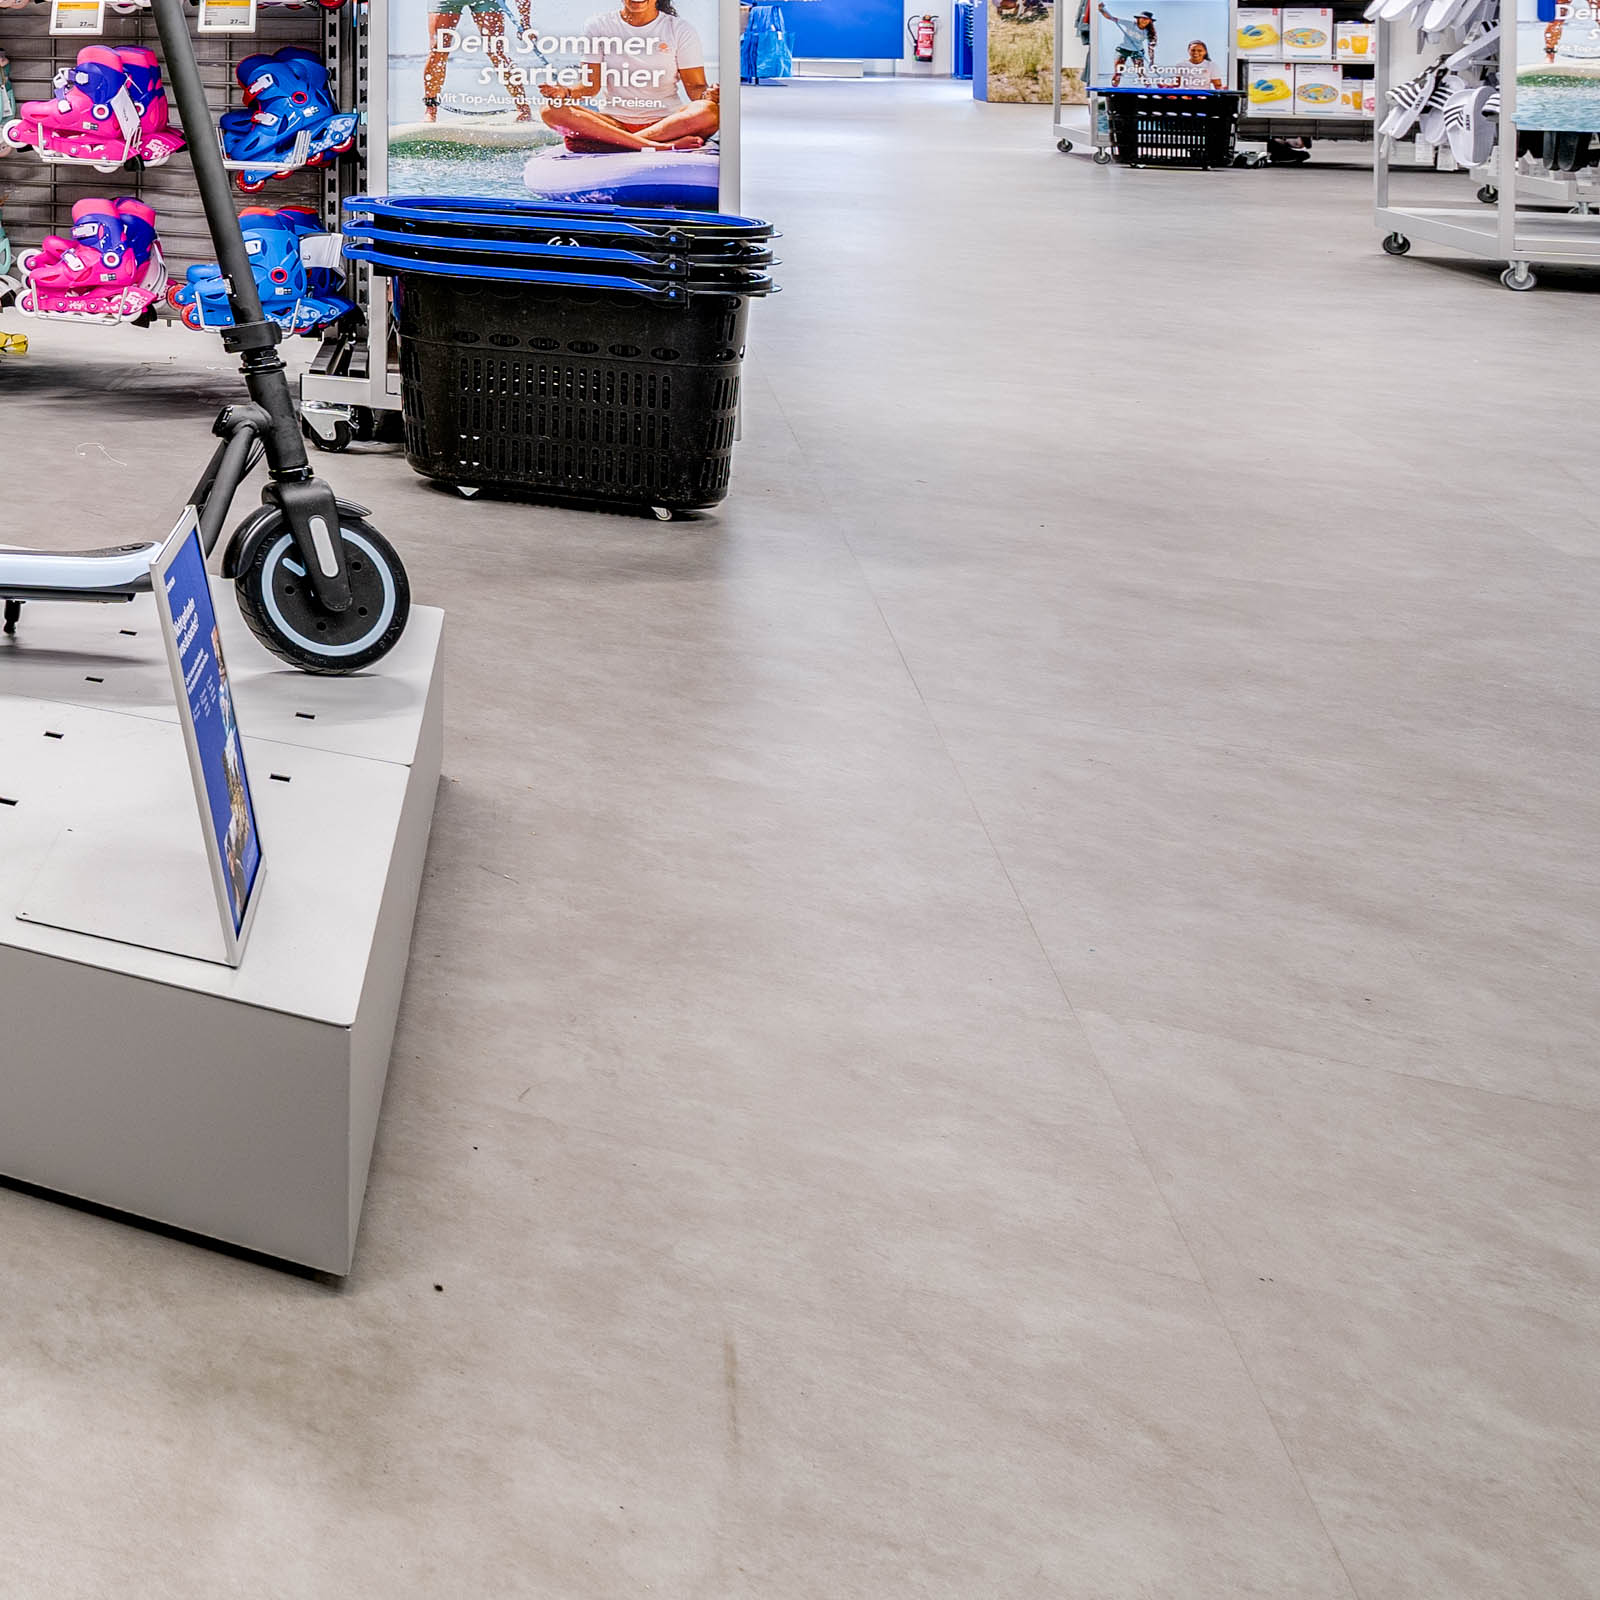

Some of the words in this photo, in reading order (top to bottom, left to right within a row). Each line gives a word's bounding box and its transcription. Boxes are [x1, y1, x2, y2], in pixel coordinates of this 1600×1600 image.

[1555, 4, 1600, 20] Dei
[436, 28, 509, 54] Dein
[517, 28, 660, 56] Sommer
[478, 62, 593, 87] startet
[600, 62, 666, 88] hier
[1117, 64, 1146, 74] Dein
[1147, 64, 1204, 74] Sommer
[1133, 76, 1179, 85] startet
[1180, 76, 1207, 86] hier
[436, 93, 457, 103] Mit
[460, 94, 562, 108] Top-Ausrüstung
[565, 97, 581, 106] zu
[582, 95, 666, 109] Top-Preisen.
